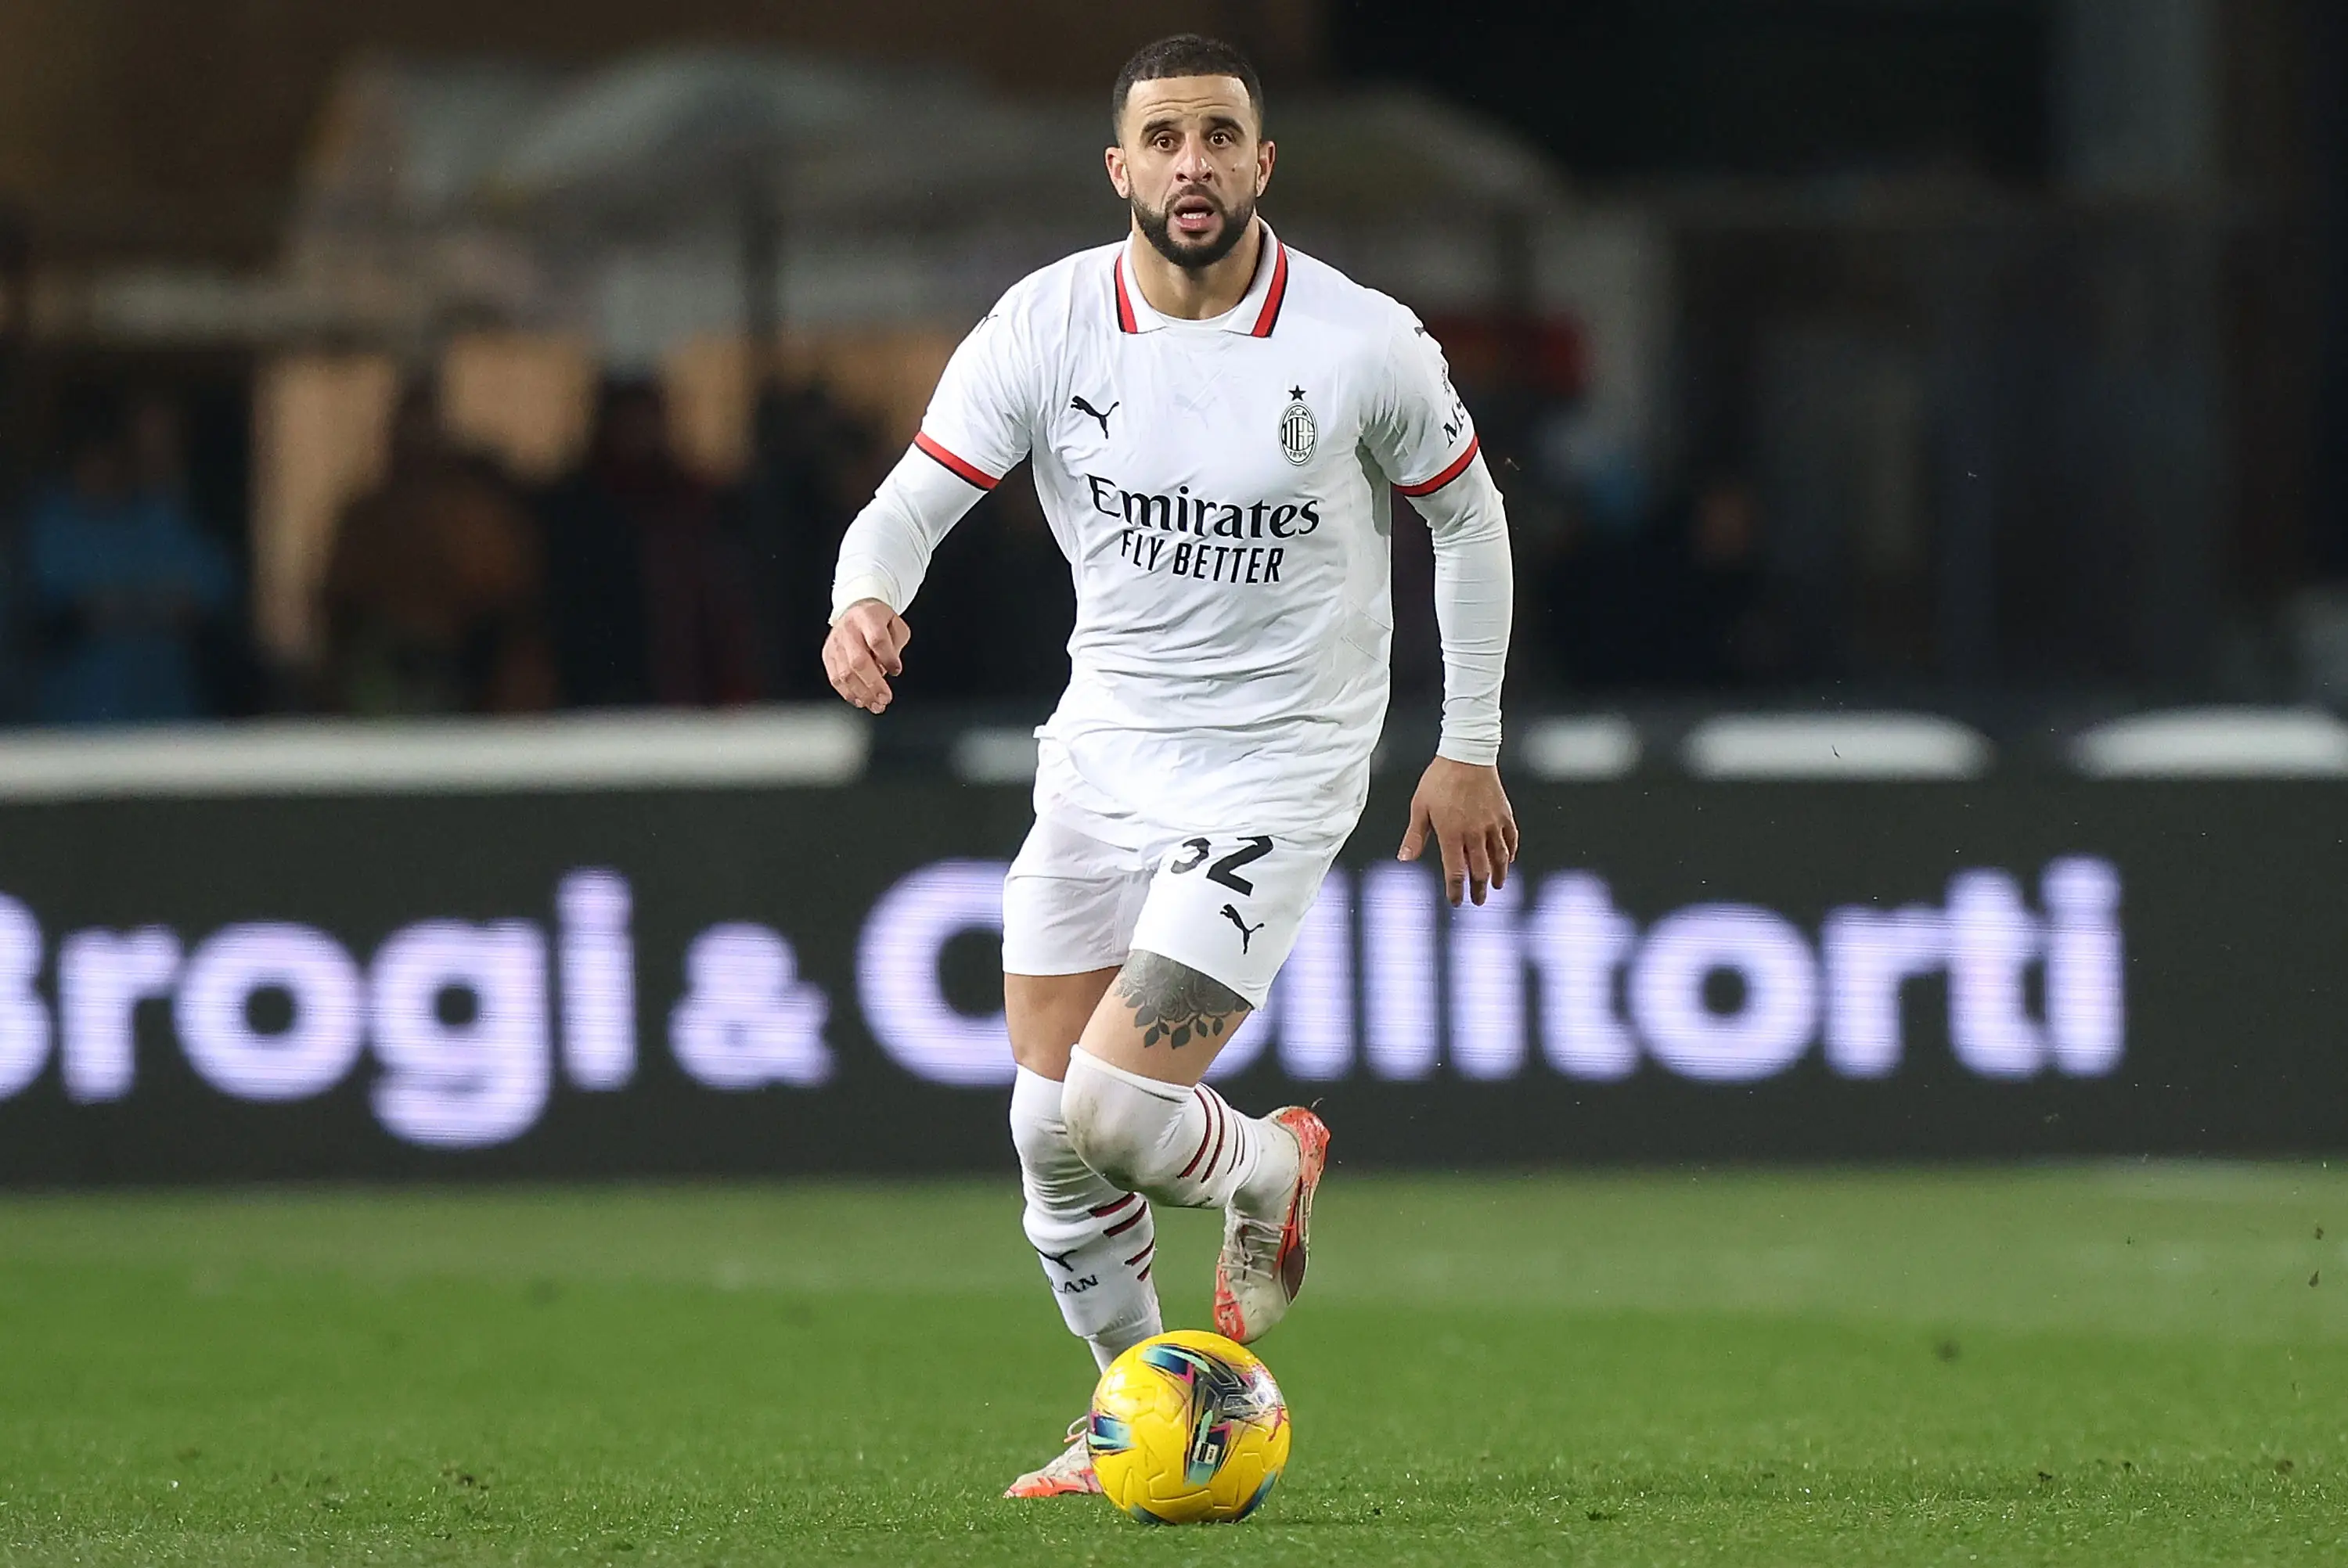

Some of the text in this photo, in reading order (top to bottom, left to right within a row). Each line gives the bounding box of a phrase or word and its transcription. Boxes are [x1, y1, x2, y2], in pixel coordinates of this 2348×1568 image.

[1289, 408, 1308, 419] ACM
[1086, 473, 1320, 540] Emirates
[1121, 530, 1285, 584] FLY BETTER
[670, 923, 828, 1088] &
[856, 858, 2123, 1084] Cllitorti
